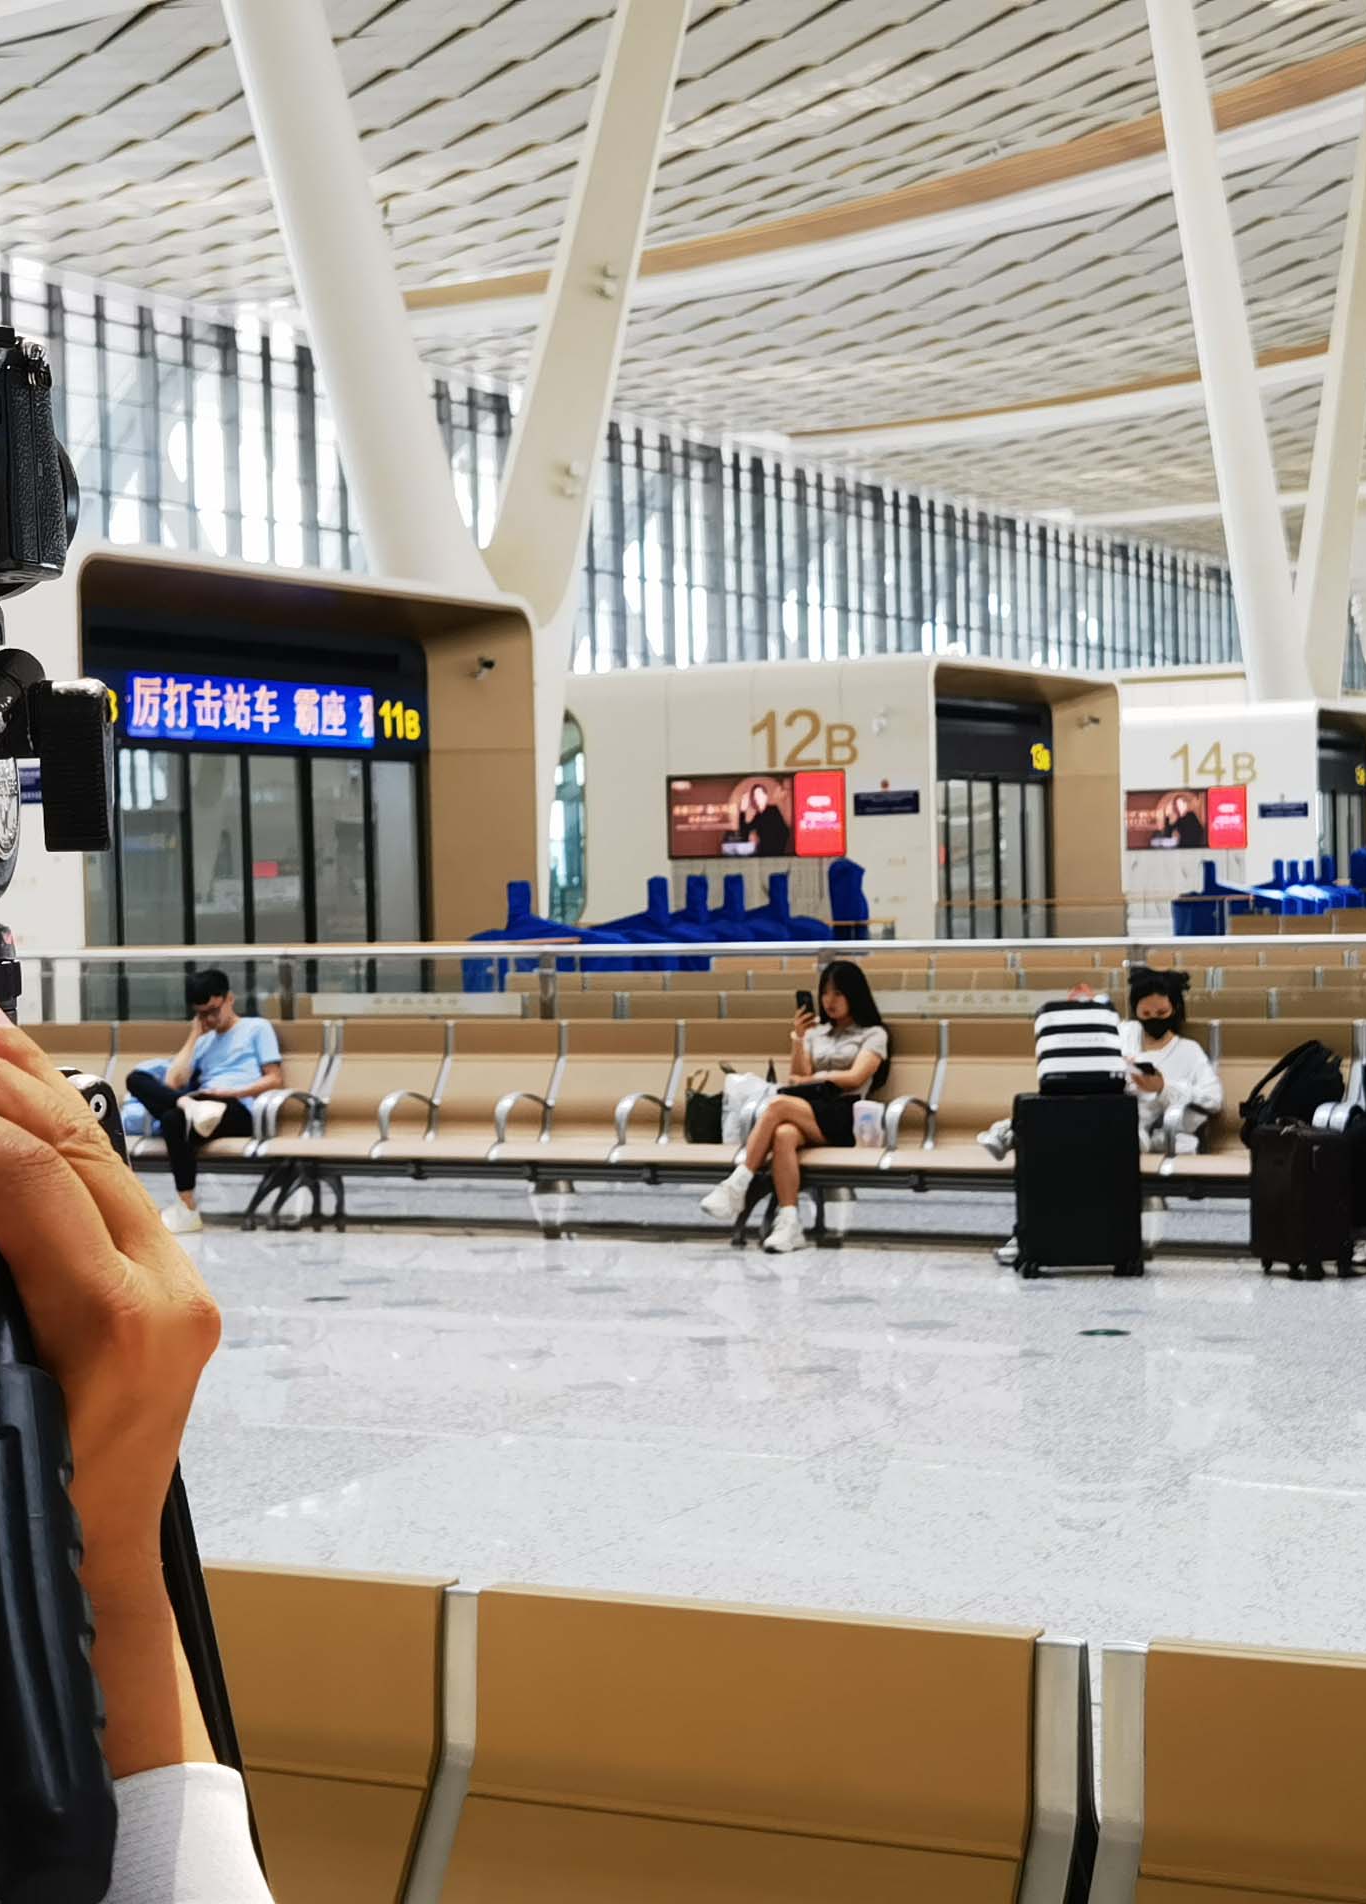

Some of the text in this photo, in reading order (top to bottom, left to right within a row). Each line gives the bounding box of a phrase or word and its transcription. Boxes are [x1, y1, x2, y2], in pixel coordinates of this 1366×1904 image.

[131, 676, 281, 734] 厉打击站车
[378, 699, 422, 741] 11B
[750, 708, 860, 768] 12B
[1169, 741, 1258, 786] 14B
